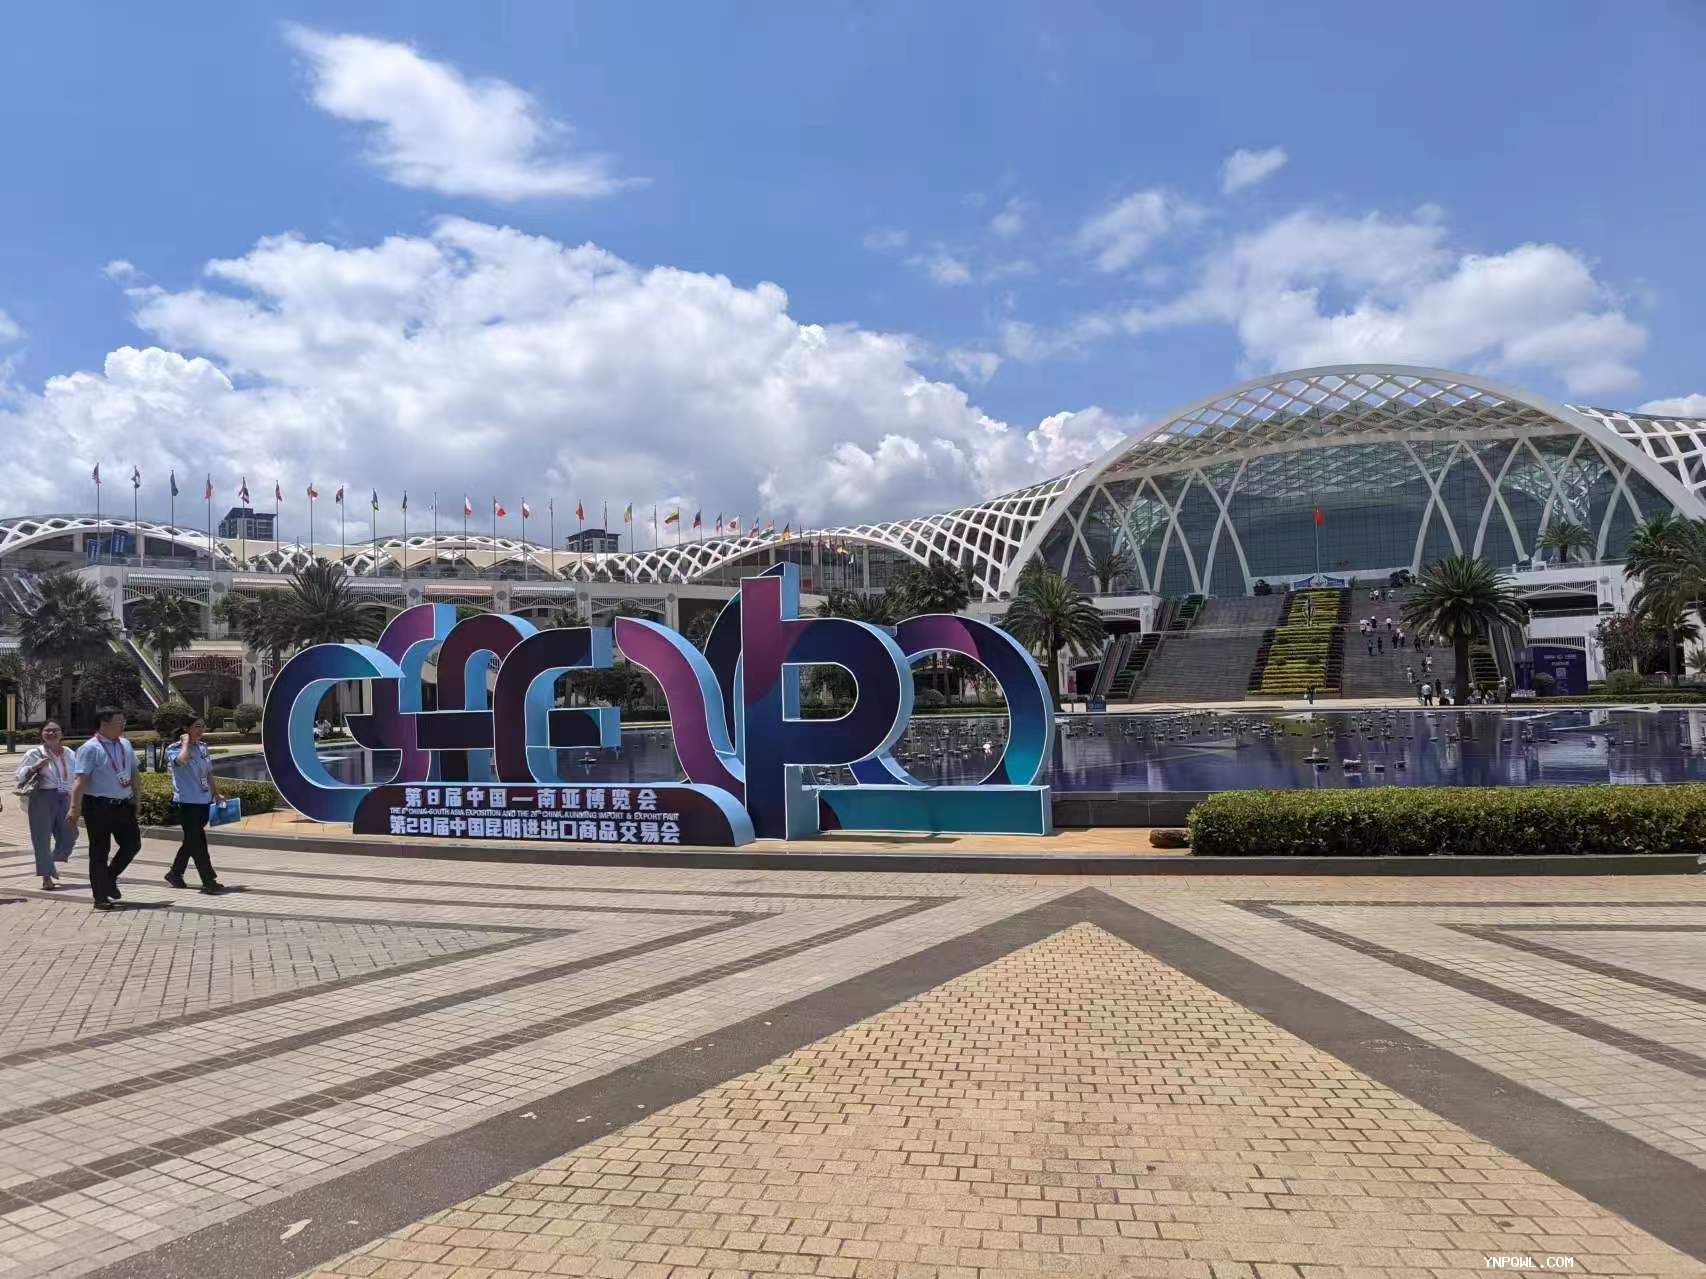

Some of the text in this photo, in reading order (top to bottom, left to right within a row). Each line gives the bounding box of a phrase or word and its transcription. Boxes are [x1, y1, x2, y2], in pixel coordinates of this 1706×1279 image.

[517, 810, 529, 818] THE
[634, 812, 661, 821] EXPORT
[389, 814, 681, 843] 第28届中国昆明进出口商品交易会
